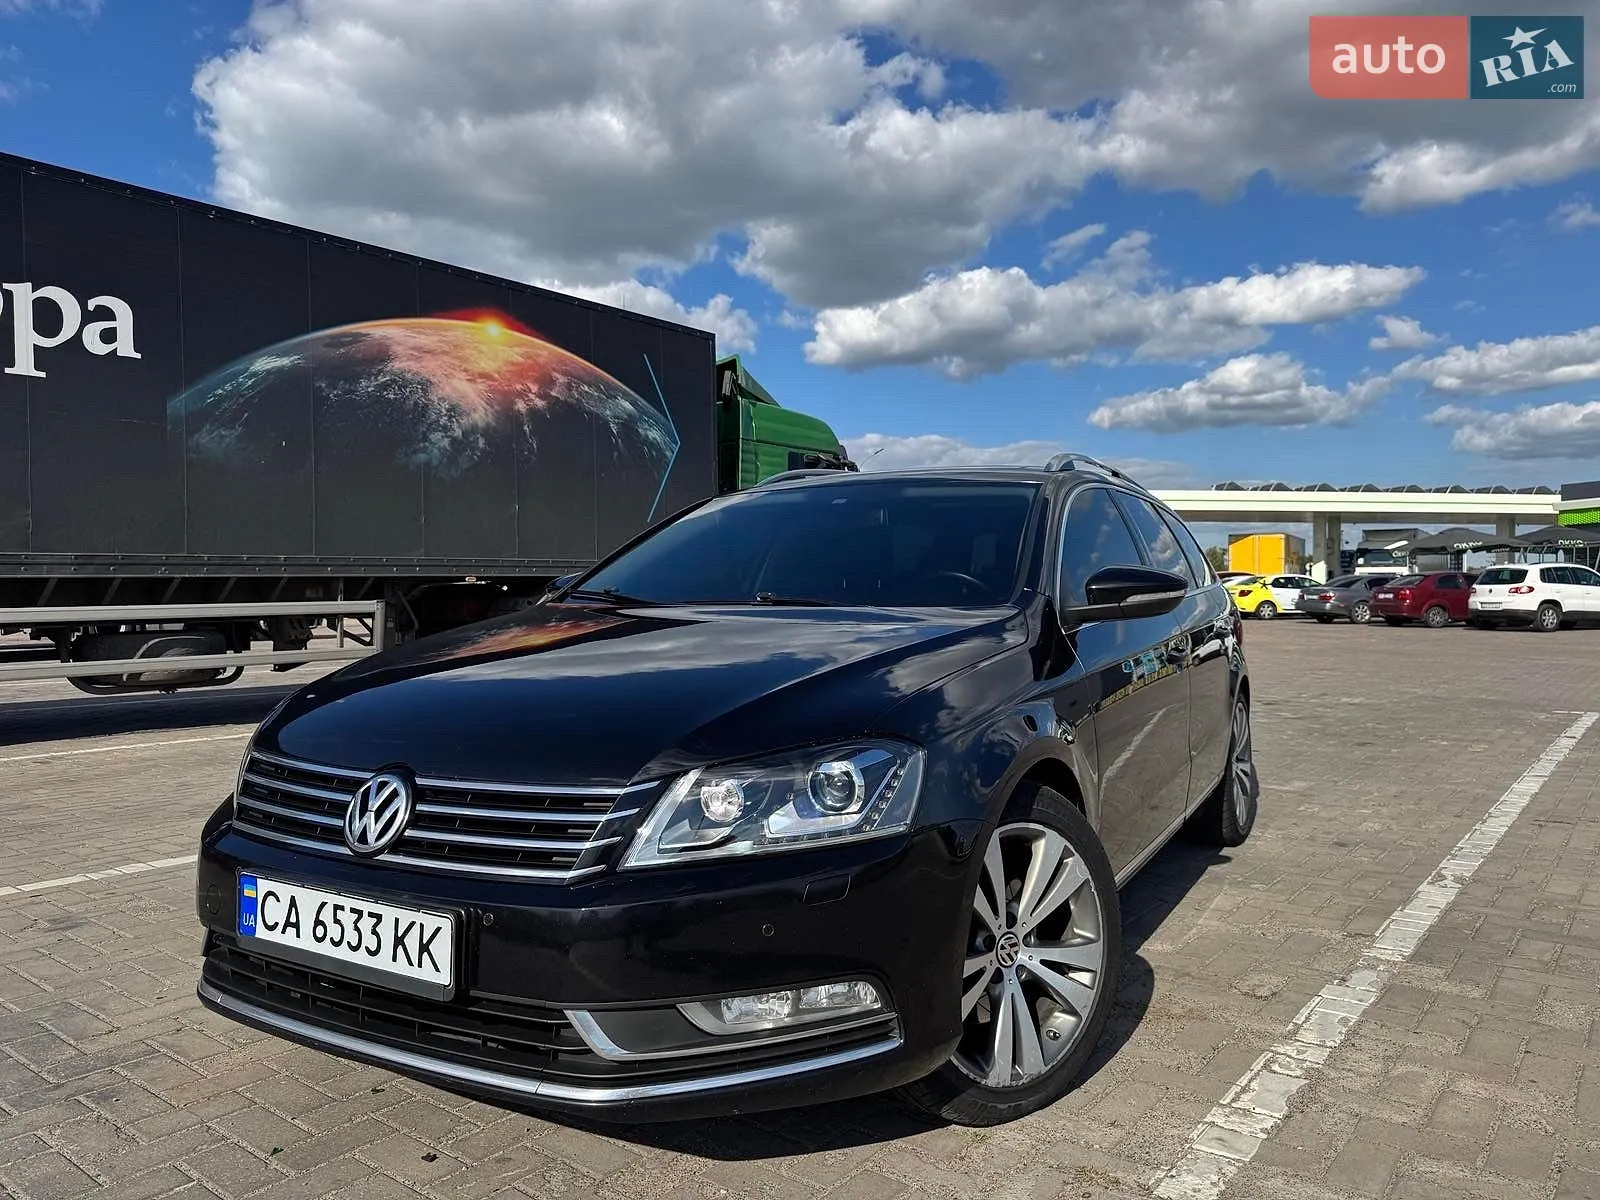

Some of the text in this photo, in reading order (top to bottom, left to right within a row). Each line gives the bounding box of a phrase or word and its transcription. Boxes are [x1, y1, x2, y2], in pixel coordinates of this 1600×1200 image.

[0, 282, 142, 378] ра
[242, 912, 256, 928] UA
[260, 890, 443, 973] CA 6533 KK
